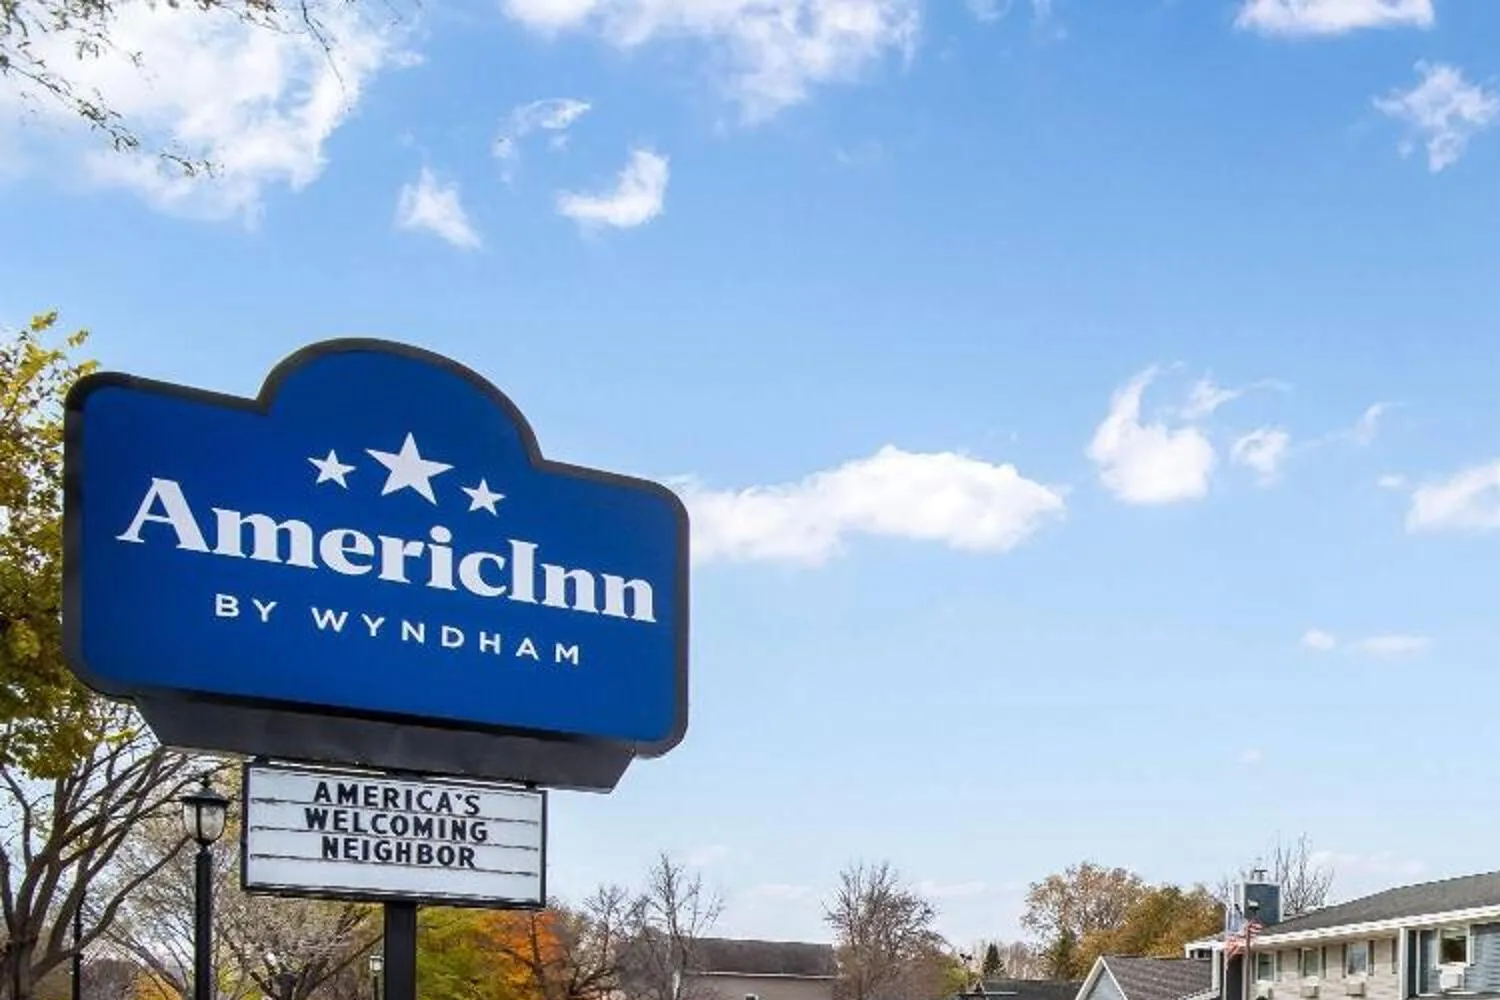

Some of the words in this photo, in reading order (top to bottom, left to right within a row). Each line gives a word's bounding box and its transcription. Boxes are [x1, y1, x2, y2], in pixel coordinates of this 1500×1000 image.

[116, 477, 657, 623] AmericInn
[215, 593, 277, 622] BY
[311, 607, 580, 665] WYNDHAM
[313, 781, 482, 816] AMERICA'S
[304, 807, 488, 843] WELCOMING
[321, 836, 475, 868] NEIGHBOR
